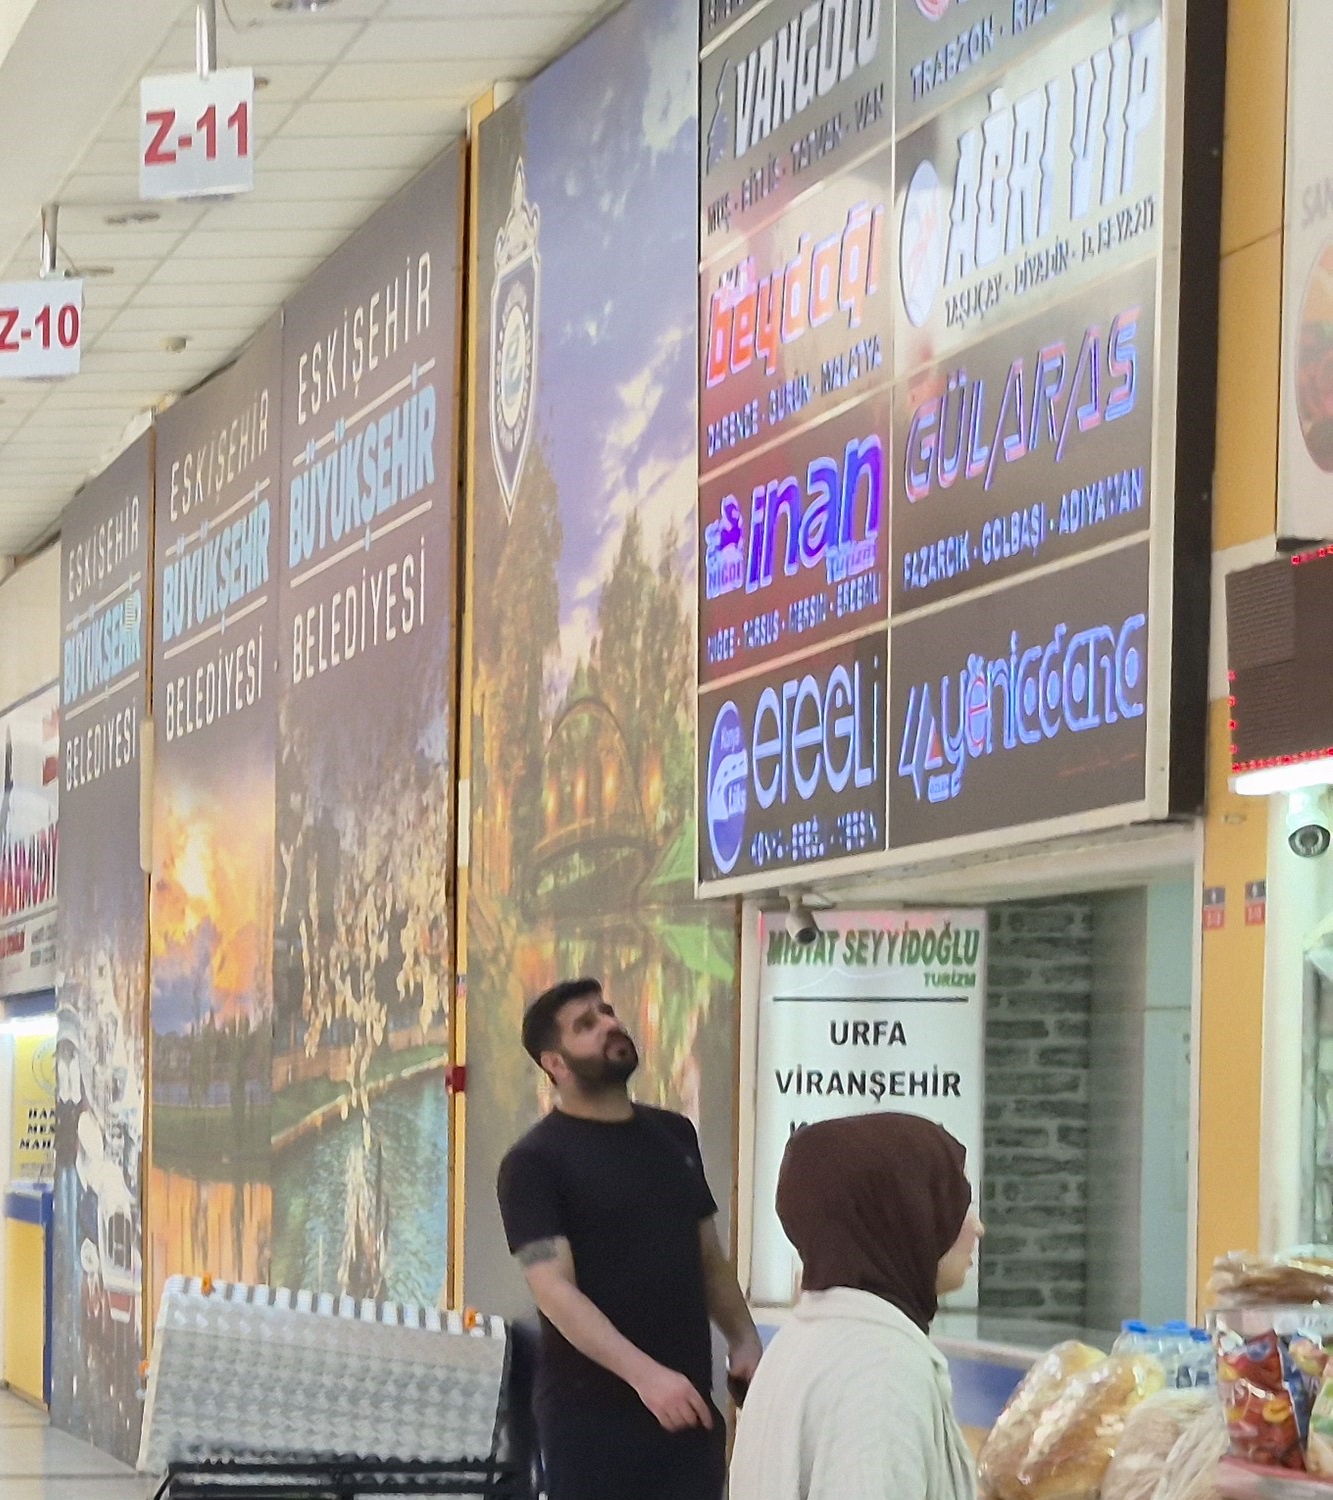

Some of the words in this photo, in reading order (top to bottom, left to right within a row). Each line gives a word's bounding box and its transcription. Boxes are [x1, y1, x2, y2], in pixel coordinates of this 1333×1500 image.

[911, 15, 994, 101] TRABZON
[145, 101, 248, 166] Z-11
[296, 252, 431, 426] ESKİŞEHİR
[169, 389, 269, 523] ESKİŞEHİR
[289, 362, 436, 568] BÜYÜKŞEHİR
[68, 496, 140, 602] ESKİŞEHİR
[162, 482, 271, 643] BÜYÜKŞEHİR
[292, 537, 426, 684] BELEDİYESİ
[166, 624, 265, 742] BELEDİYESİ
[65, 697, 136, 792] BELEDİYESİ
[843, 918, 981, 967] SEYYİDOĞLU
[924, 970, 976, 988] TURİZM
[830, 1019, 907, 1046] URFA
[775, 1064, 962, 1103] VİRANŞEHİR
